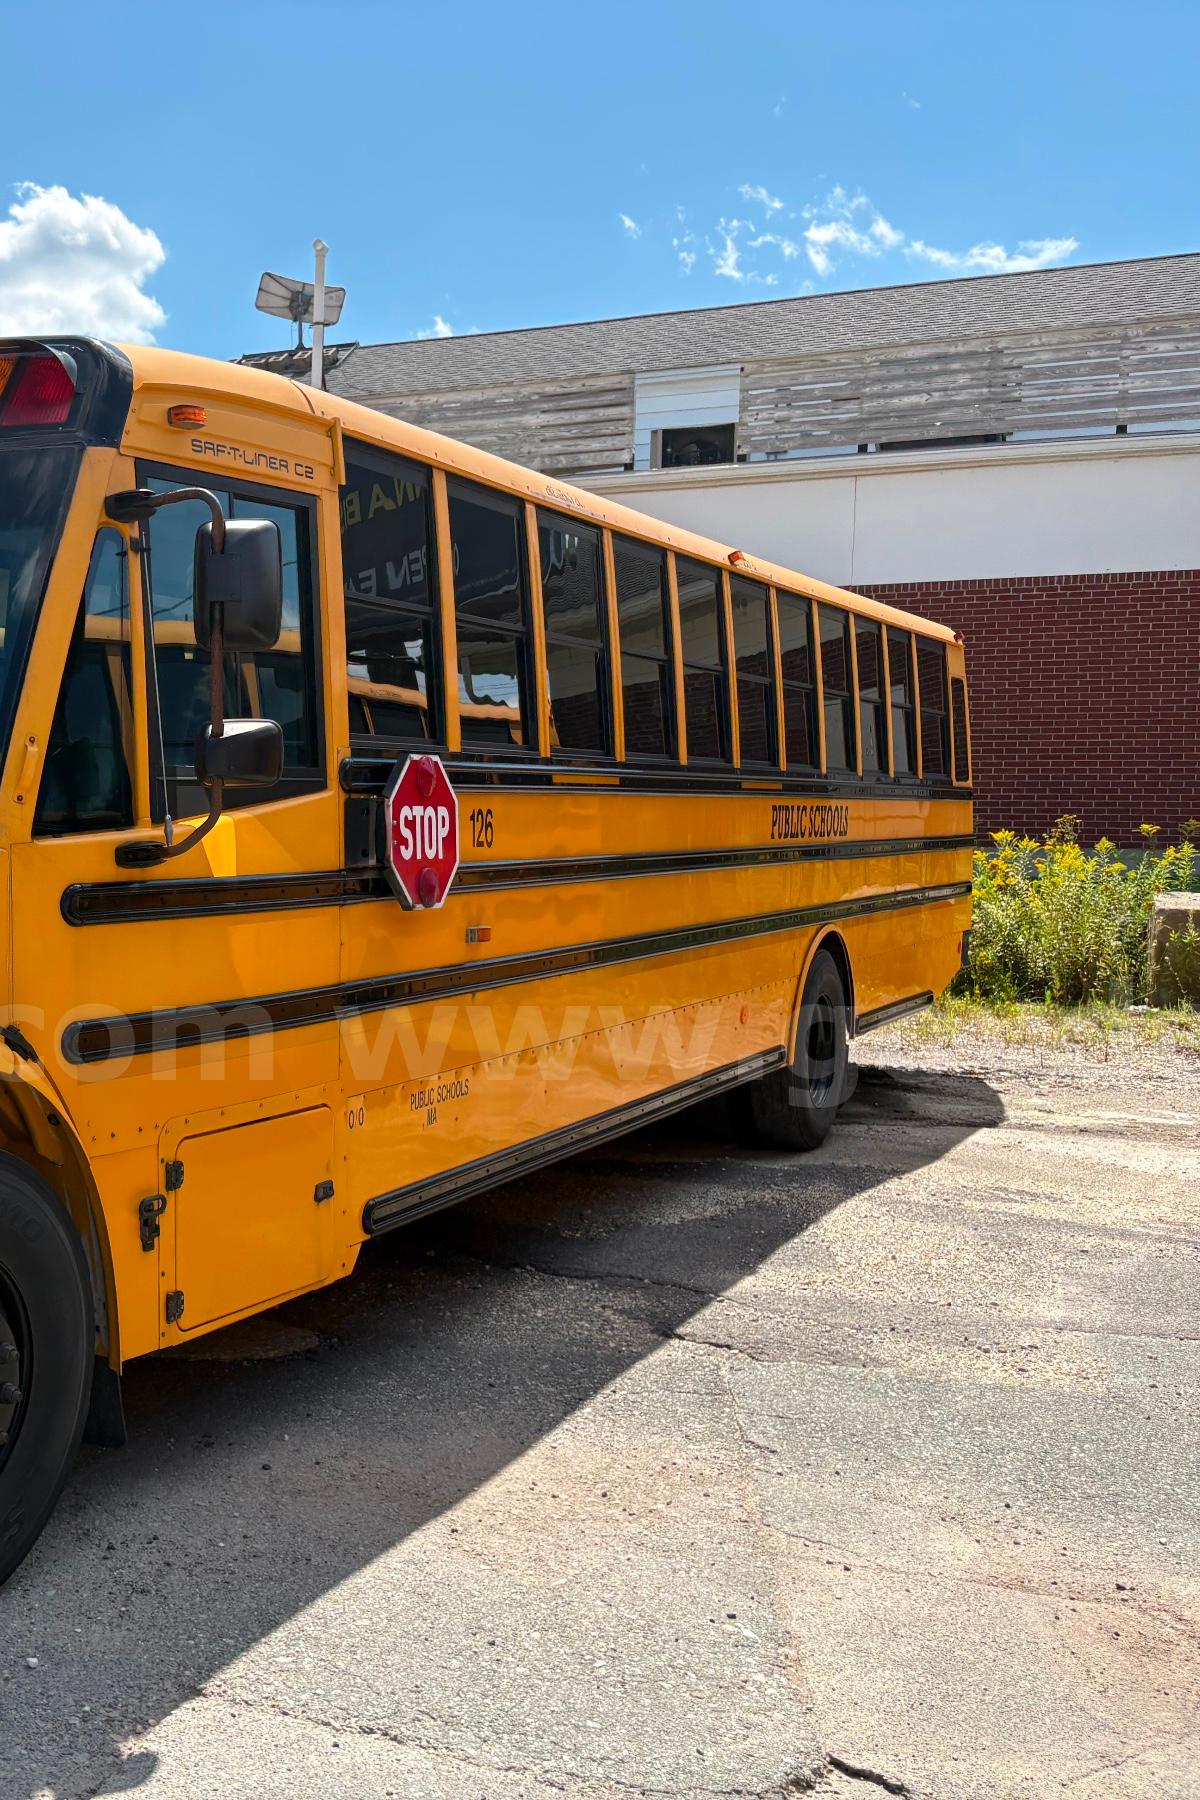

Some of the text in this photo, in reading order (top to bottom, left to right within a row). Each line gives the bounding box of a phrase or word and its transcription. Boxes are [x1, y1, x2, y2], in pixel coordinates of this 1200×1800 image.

[294, 463, 314, 480] C2
[399, 805, 450, 861] STOP
[469, 808, 494, 848] 126
[770, 804, 849, 840] PUBLIC SCHOOLS
[410, 1078, 470, 1111] PUBLIC SCHOOLS
[426, 1107, 438, 1126] MA
